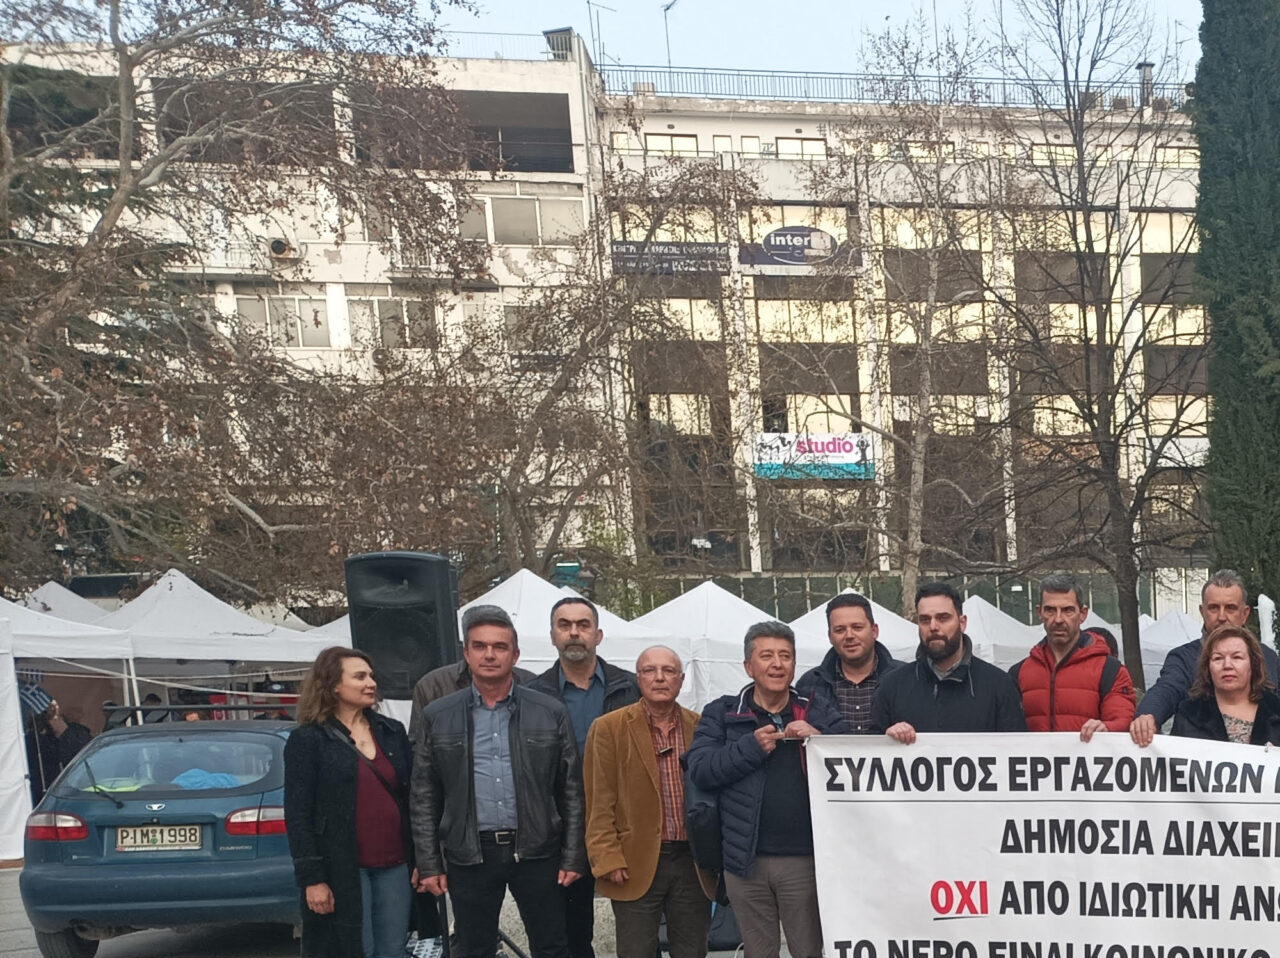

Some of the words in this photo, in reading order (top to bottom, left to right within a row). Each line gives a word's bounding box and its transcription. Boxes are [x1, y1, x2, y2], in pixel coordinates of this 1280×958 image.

[796, 437, 853, 453] studio
[824, 756, 998, 792] ΣΥΛΛΟΓΟΣ
[1008, 756, 1265, 793] ΕΡΓΑΖΟΜΕΝΩΝ
[1000, 818, 1154, 855] ΔΗΜΟΣΙΑ
[930, 880, 989, 915] ΟΧΙ
[999, 880, 1070, 916] ΑΠΟ
[1079, 881, 1220, 920] ΙΔΙΩΤΙΚΗ
